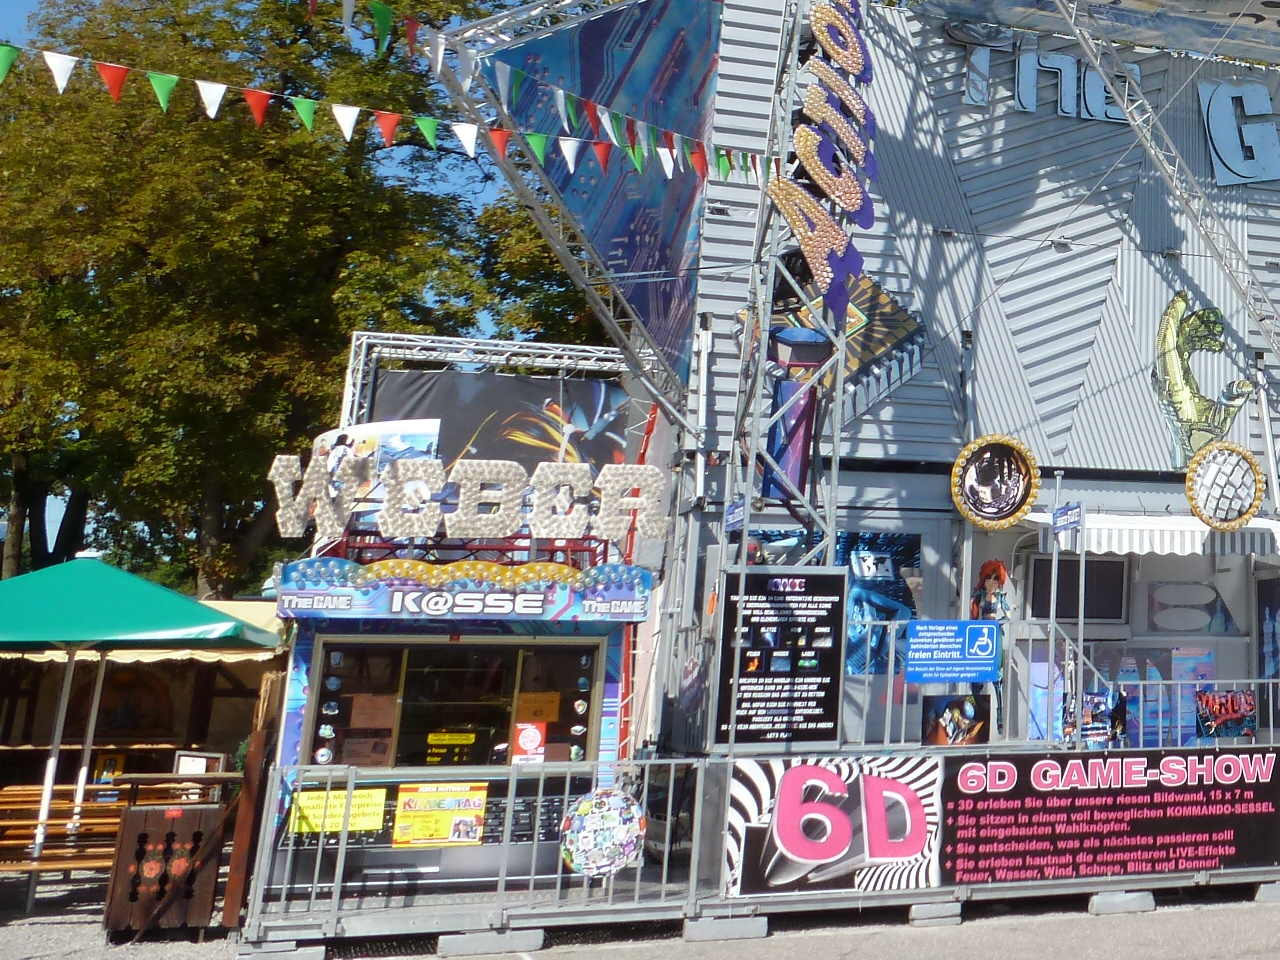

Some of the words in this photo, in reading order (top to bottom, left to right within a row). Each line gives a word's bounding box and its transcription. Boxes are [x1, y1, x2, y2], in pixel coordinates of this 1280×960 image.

[944, 21, 1142, 124] The
[267, 454, 673, 541] WEBER
[391, 590, 547, 617] K@SSE
[908, 650, 932, 658] freien
[958, 760, 1017, 793] 6D
[1030, 753, 1276, 791] GAME-SHOW
[958, 799, 973, 811] 3D
[977, 798, 1021, 810] erleben
[1025, 797, 1043, 809] Sie
[1047, 796, 1072, 808] über
[1075, 796, 1114, 806] unsere
[1117, 794, 1150, 805] riesen
[1154, 791, 1207, 803] Bildwand,
[1210, 790, 1222, 801] 15
[1235, 789, 1241, 799] 7
[1244, 790, 1254, 800] m
[775, 764, 931, 866] 6D
[957, 814, 976, 826] Sie
[980, 813, 1015, 825] sitzen
[1018, 813, 1029, 824] in
[1032, 813, 1067, 823] einem
[1071, 810, 1091, 821] voll
[1094, 806, 1163, 822] beweglichen
[1167, 802, 1275, 817] KOMMANDO-SESSEL
[956, 842, 976, 854] Sie
[979, 840, 1054, 853] entscheiden,
[1057, 839, 1080, 849] was
[1083, 837, 1100, 848] als
[1103, 834, 1154, 847] nächstes
[1157, 832, 1209, 846] passieren
[957, 827, 976, 838] mit
[980, 825, 1052, 840] eingebauten
[1055, 821, 1131, 836] Wahlknöpfen.
[956, 858, 975, 870] Sie
[978, 857, 1023, 869] erleben
[1026, 854, 1073, 867] hautnah
[1076, 852, 1093, 864] die
[1097, 849, 1166, 863] elementaren
[1170, 845, 1236, 858] LIVE-Effekte
[956, 871, 991, 883] Feuer,
[995, 868, 1041, 881] Wasser,
[1044, 866, 1076, 879] Wind,
[1079, 863, 1124, 876] Schnee,
[1127, 861, 1152, 873] Blitz
[1155, 859, 1176, 871] und
[1179, 857, 1219, 869] Donner!
